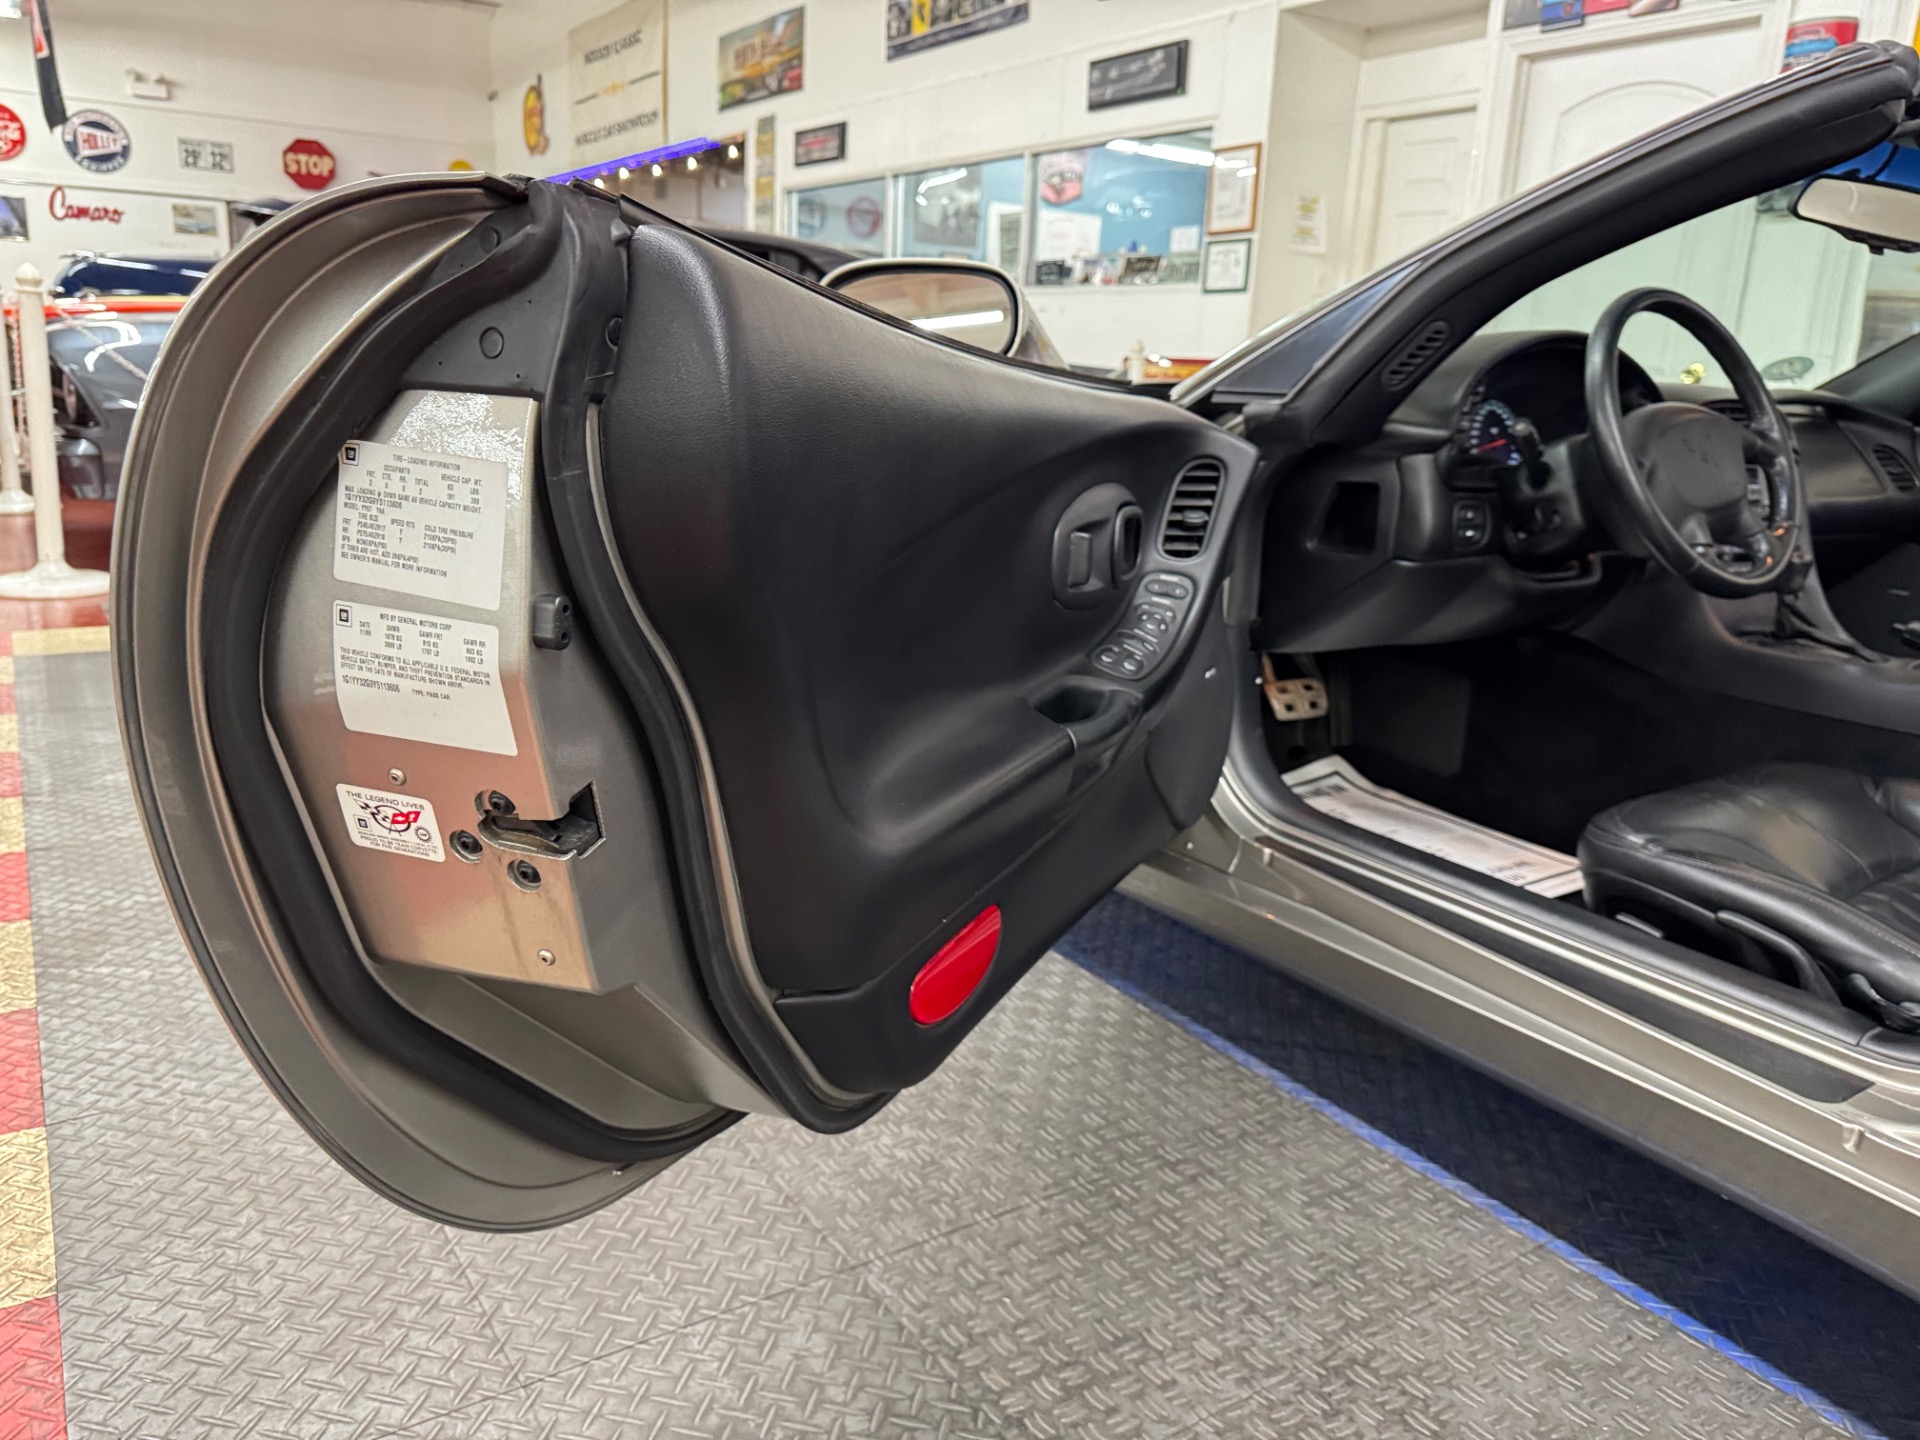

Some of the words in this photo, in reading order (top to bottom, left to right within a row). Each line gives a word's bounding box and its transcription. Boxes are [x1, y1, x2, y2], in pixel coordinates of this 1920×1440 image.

[286, 152, 333, 177] STOP
[49, 186, 124, 224] Camaro
[384, 464, 411, 475] OCCUPANTS
[429, 460, 460, 471] INFORMATION
[415, 478, 429, 487] TOTAL
[441, 474, 460, 483] VEHICLE
[357, 487, 376, 496] LOADING
[398, 494, 410, 502] SAME
[419, 497, 438, 507] VEHICLE
[439, 500, 461, 511] CAPACITY
[470, 488, 479, 496] LBS
[358, 512, 368, 520] TIRE
[369, 514, 379, 522] SIZE
[391, 518, 405, 527] SPEED
[424, 524, 436, 533] COLD
[438, 526, 448, 535] TIRE
[450, 529, 474, 540] PRESSURE
[347, 544, 359, 552] TIRES
[360, 546, 369, 554] ARE
[350, 553, 370, 563] OWNER'S
[371, 557, 390, 567] MANUAL
[402, 563, 414, 572] MORE
[416, 565, 447, 577] INFORMATION
[359, 621, 370, 629] DATE
[419, 630, 433, 639] GAWR
[398, 616, 418, 626] GENERAL
[419, 620, 438, 629] MOTORS
[340, 654, 358, 663] VEHICLE
[409, 667, 423, 676] THEFT
[425, 670, 453, 680] PREVENTION
[455, 673, 484, 685] STANDARDS
[485, 678, 491, 686] IN
[351, 648, 369, 658] VEHICLE
[370, 651, 394, 662] CONFORMS
[412, 660, 438, 670] APPLICABLE
[451, 666, 472, 676] FEDERAL
[473, 670, 490, 679] MOTOR
[341, 662, 356, 670] EFFECT
[365, 666, 373, 674] THE
[374, 668, 386, 676] DATE
[394, 672, 427, 683] MANUFACTURE
[428, 678, 446, 686] SHOWN
[346, 791, 363, 799] THE
[365, 794, 399, 806] LEGEND
[402, 801, 425, 811] LIVES
[360, 835, 378, 843] PROUD
[411, 845, 437, 854] CORVETTE
